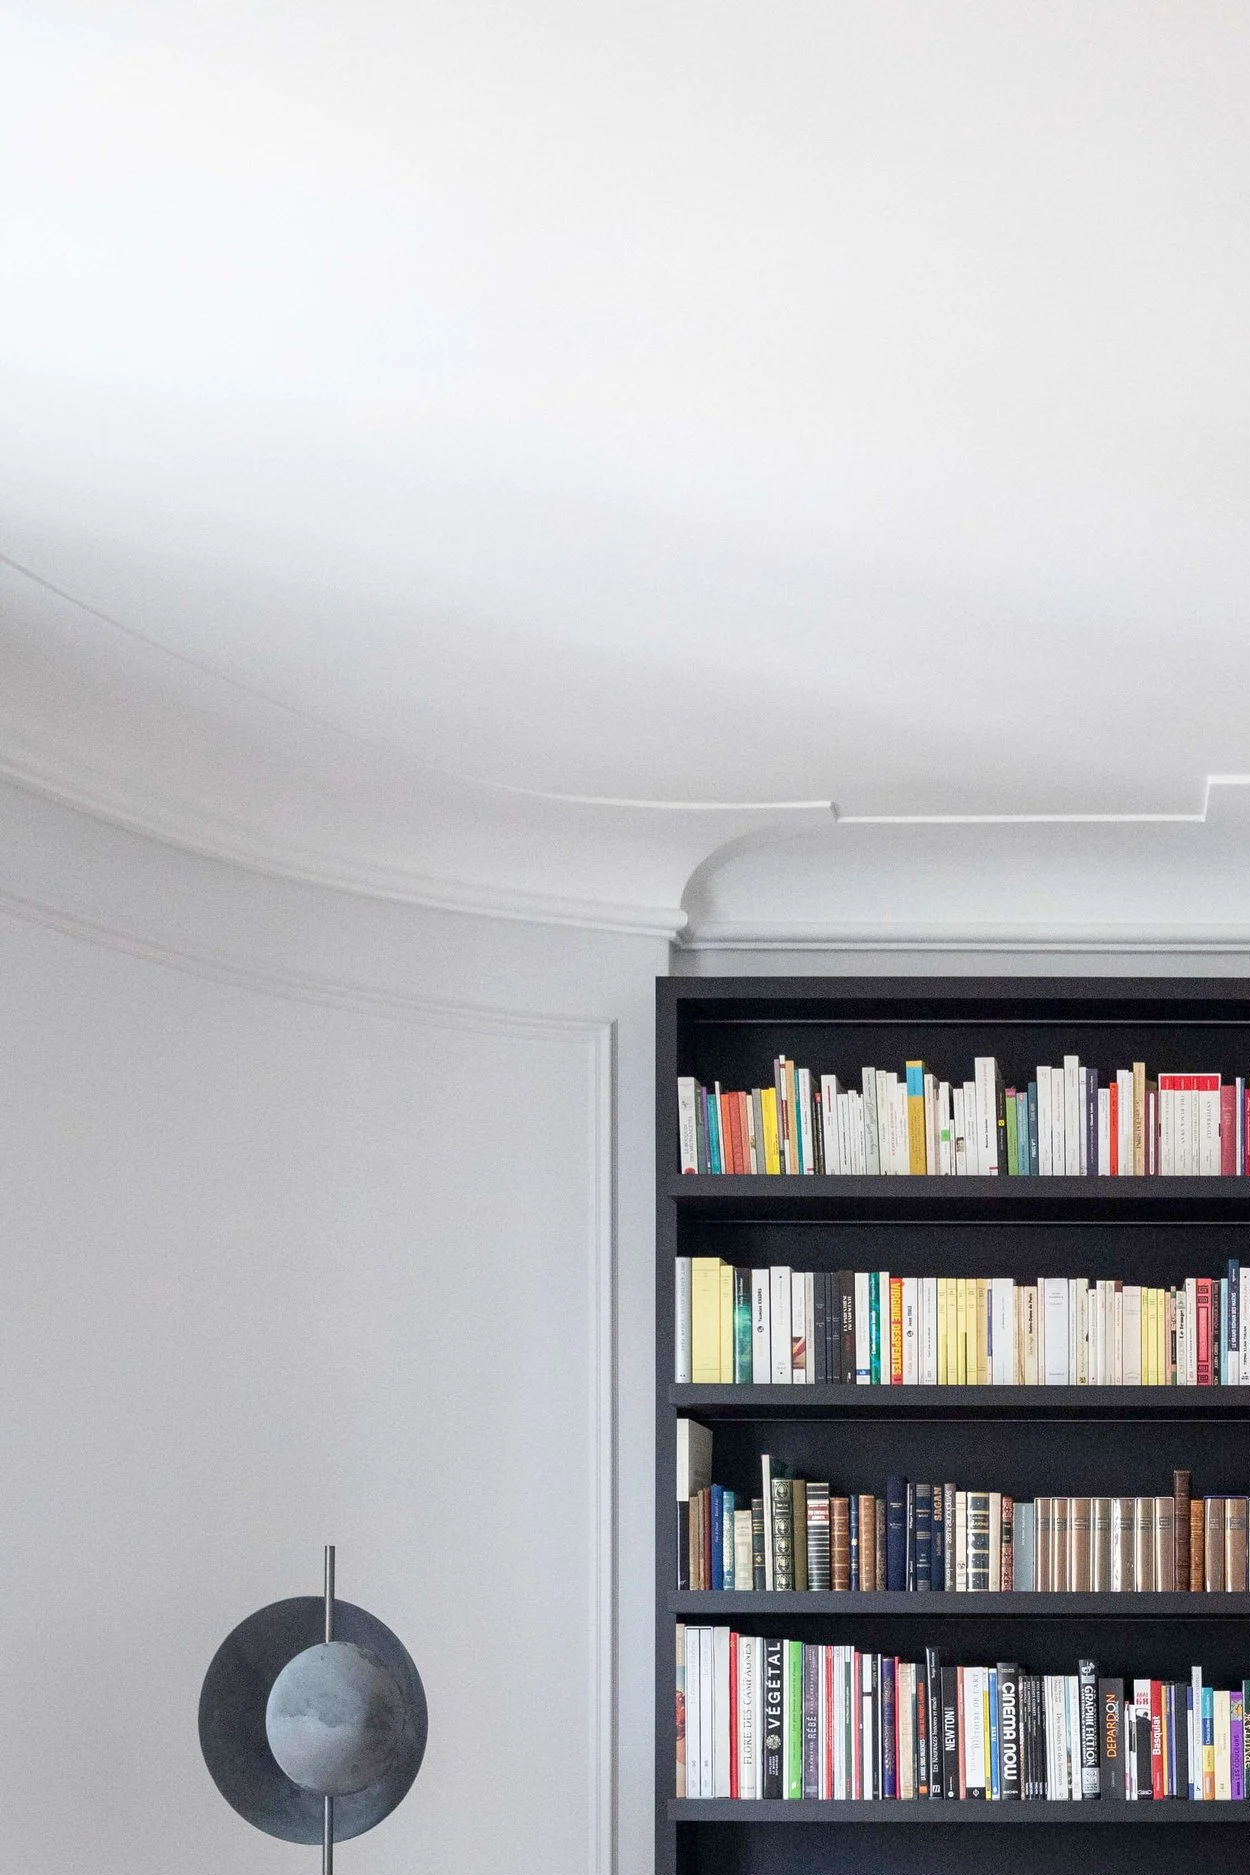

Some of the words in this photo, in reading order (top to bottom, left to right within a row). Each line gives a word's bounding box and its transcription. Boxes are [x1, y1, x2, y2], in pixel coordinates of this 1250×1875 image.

[891, 1282, 901, 1321] VIRGINIE
[891, 1323, 901, 1375] DESPENTES
[933, 1487, 942, 1521] SAGAN
[742, 1642, 752, 1702] CAMPAGNES
[765, 1641, 781, 1729] VÉGÉTAL
[743, 1709, 752, 1729] DES
[1001, 1682, 1016, 1740] CINEMA
[1084, 1685, 1095, 1725] GRAPHIC
[1136, 1698, 1149, 1706] 68
[806, 1716, 817, 1739] RÉBÉ
[944, 1711, 956, 1751] NEWTON
[1106, 1693, 1117, 1758] DEPARDON
[1152, 1715, 1163, 1756] Basquiat
[743, 1731, 753, 1765] FLORE
[1003, 1743, 1017, 1780] NOW
[1086, 1727, 1096, 1766] FICTION
